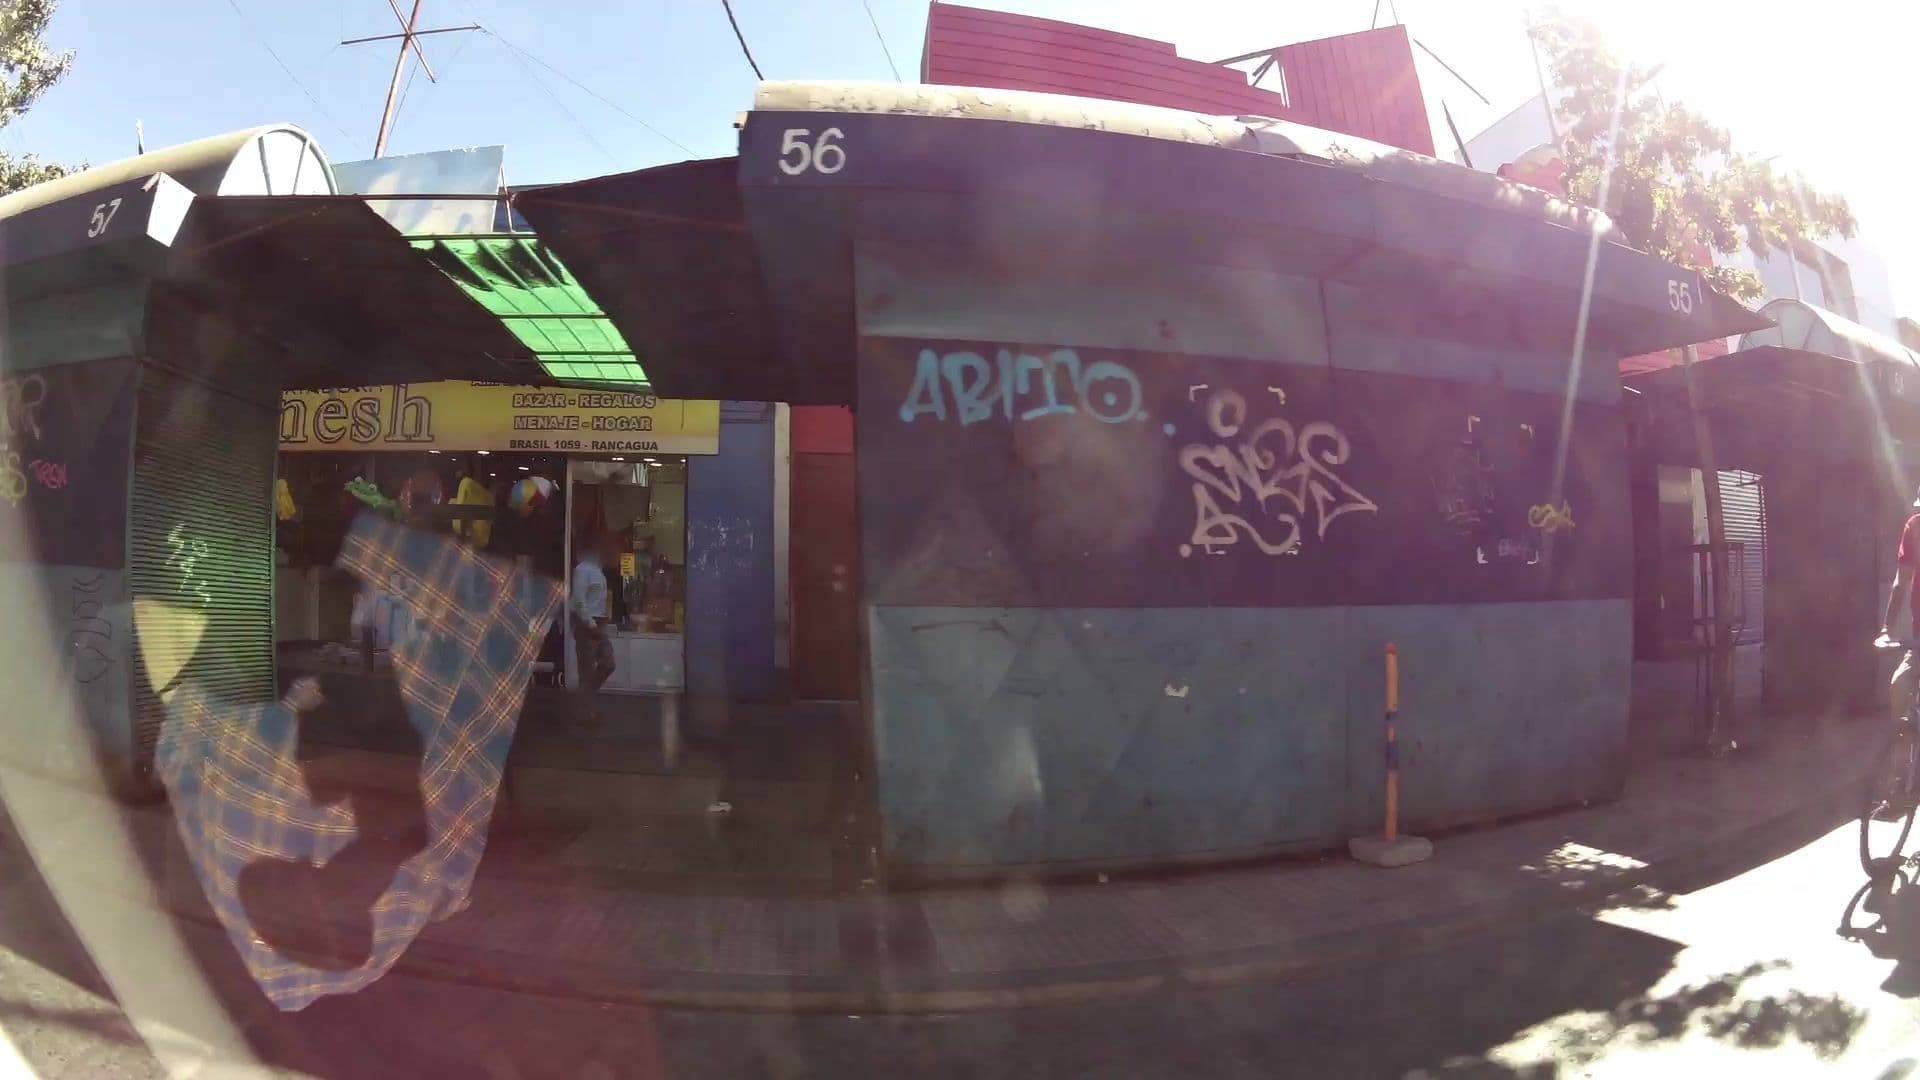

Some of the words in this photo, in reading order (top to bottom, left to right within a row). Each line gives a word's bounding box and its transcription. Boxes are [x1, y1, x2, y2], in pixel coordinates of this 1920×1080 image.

[778, 127, 846, 175] 56
[87, 198, 122, 239] 57
[1667, 279, 1693, 315] 55
[512, 394, 566, 408] BAZAR
[578, 394, 657, 408] REGALOS
[514, 415, 580, 431] MENAJE
[591, 416, 653, 431] HOGAR
[510, 439, 551, 449] BRASIL
[553, 440, 581, 449] 1059
[591, 440, 658, 450] RANCAGUA
